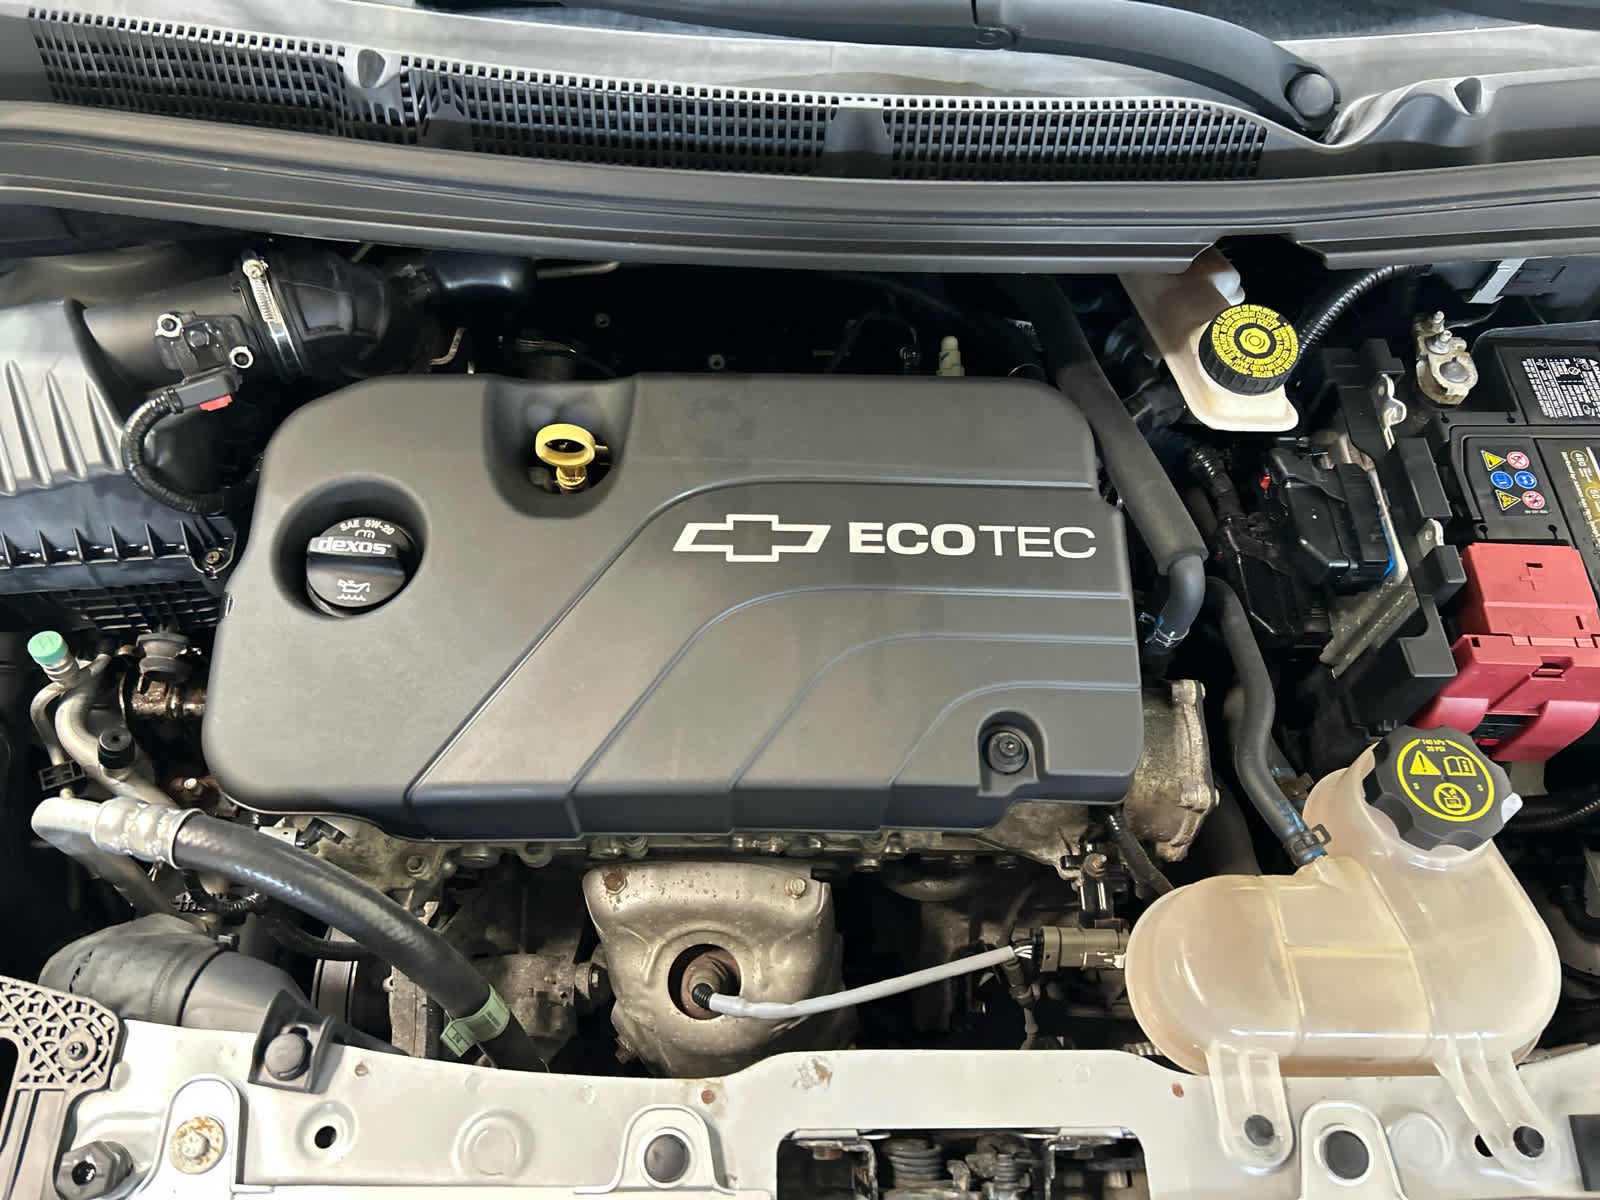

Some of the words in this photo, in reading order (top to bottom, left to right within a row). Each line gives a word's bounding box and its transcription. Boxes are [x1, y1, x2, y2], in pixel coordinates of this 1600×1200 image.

[339, 519, 361, 532] SAE
[364, 519, 396, 536] 5W-20
[848, 522, 1098, 559] ECOTEC
